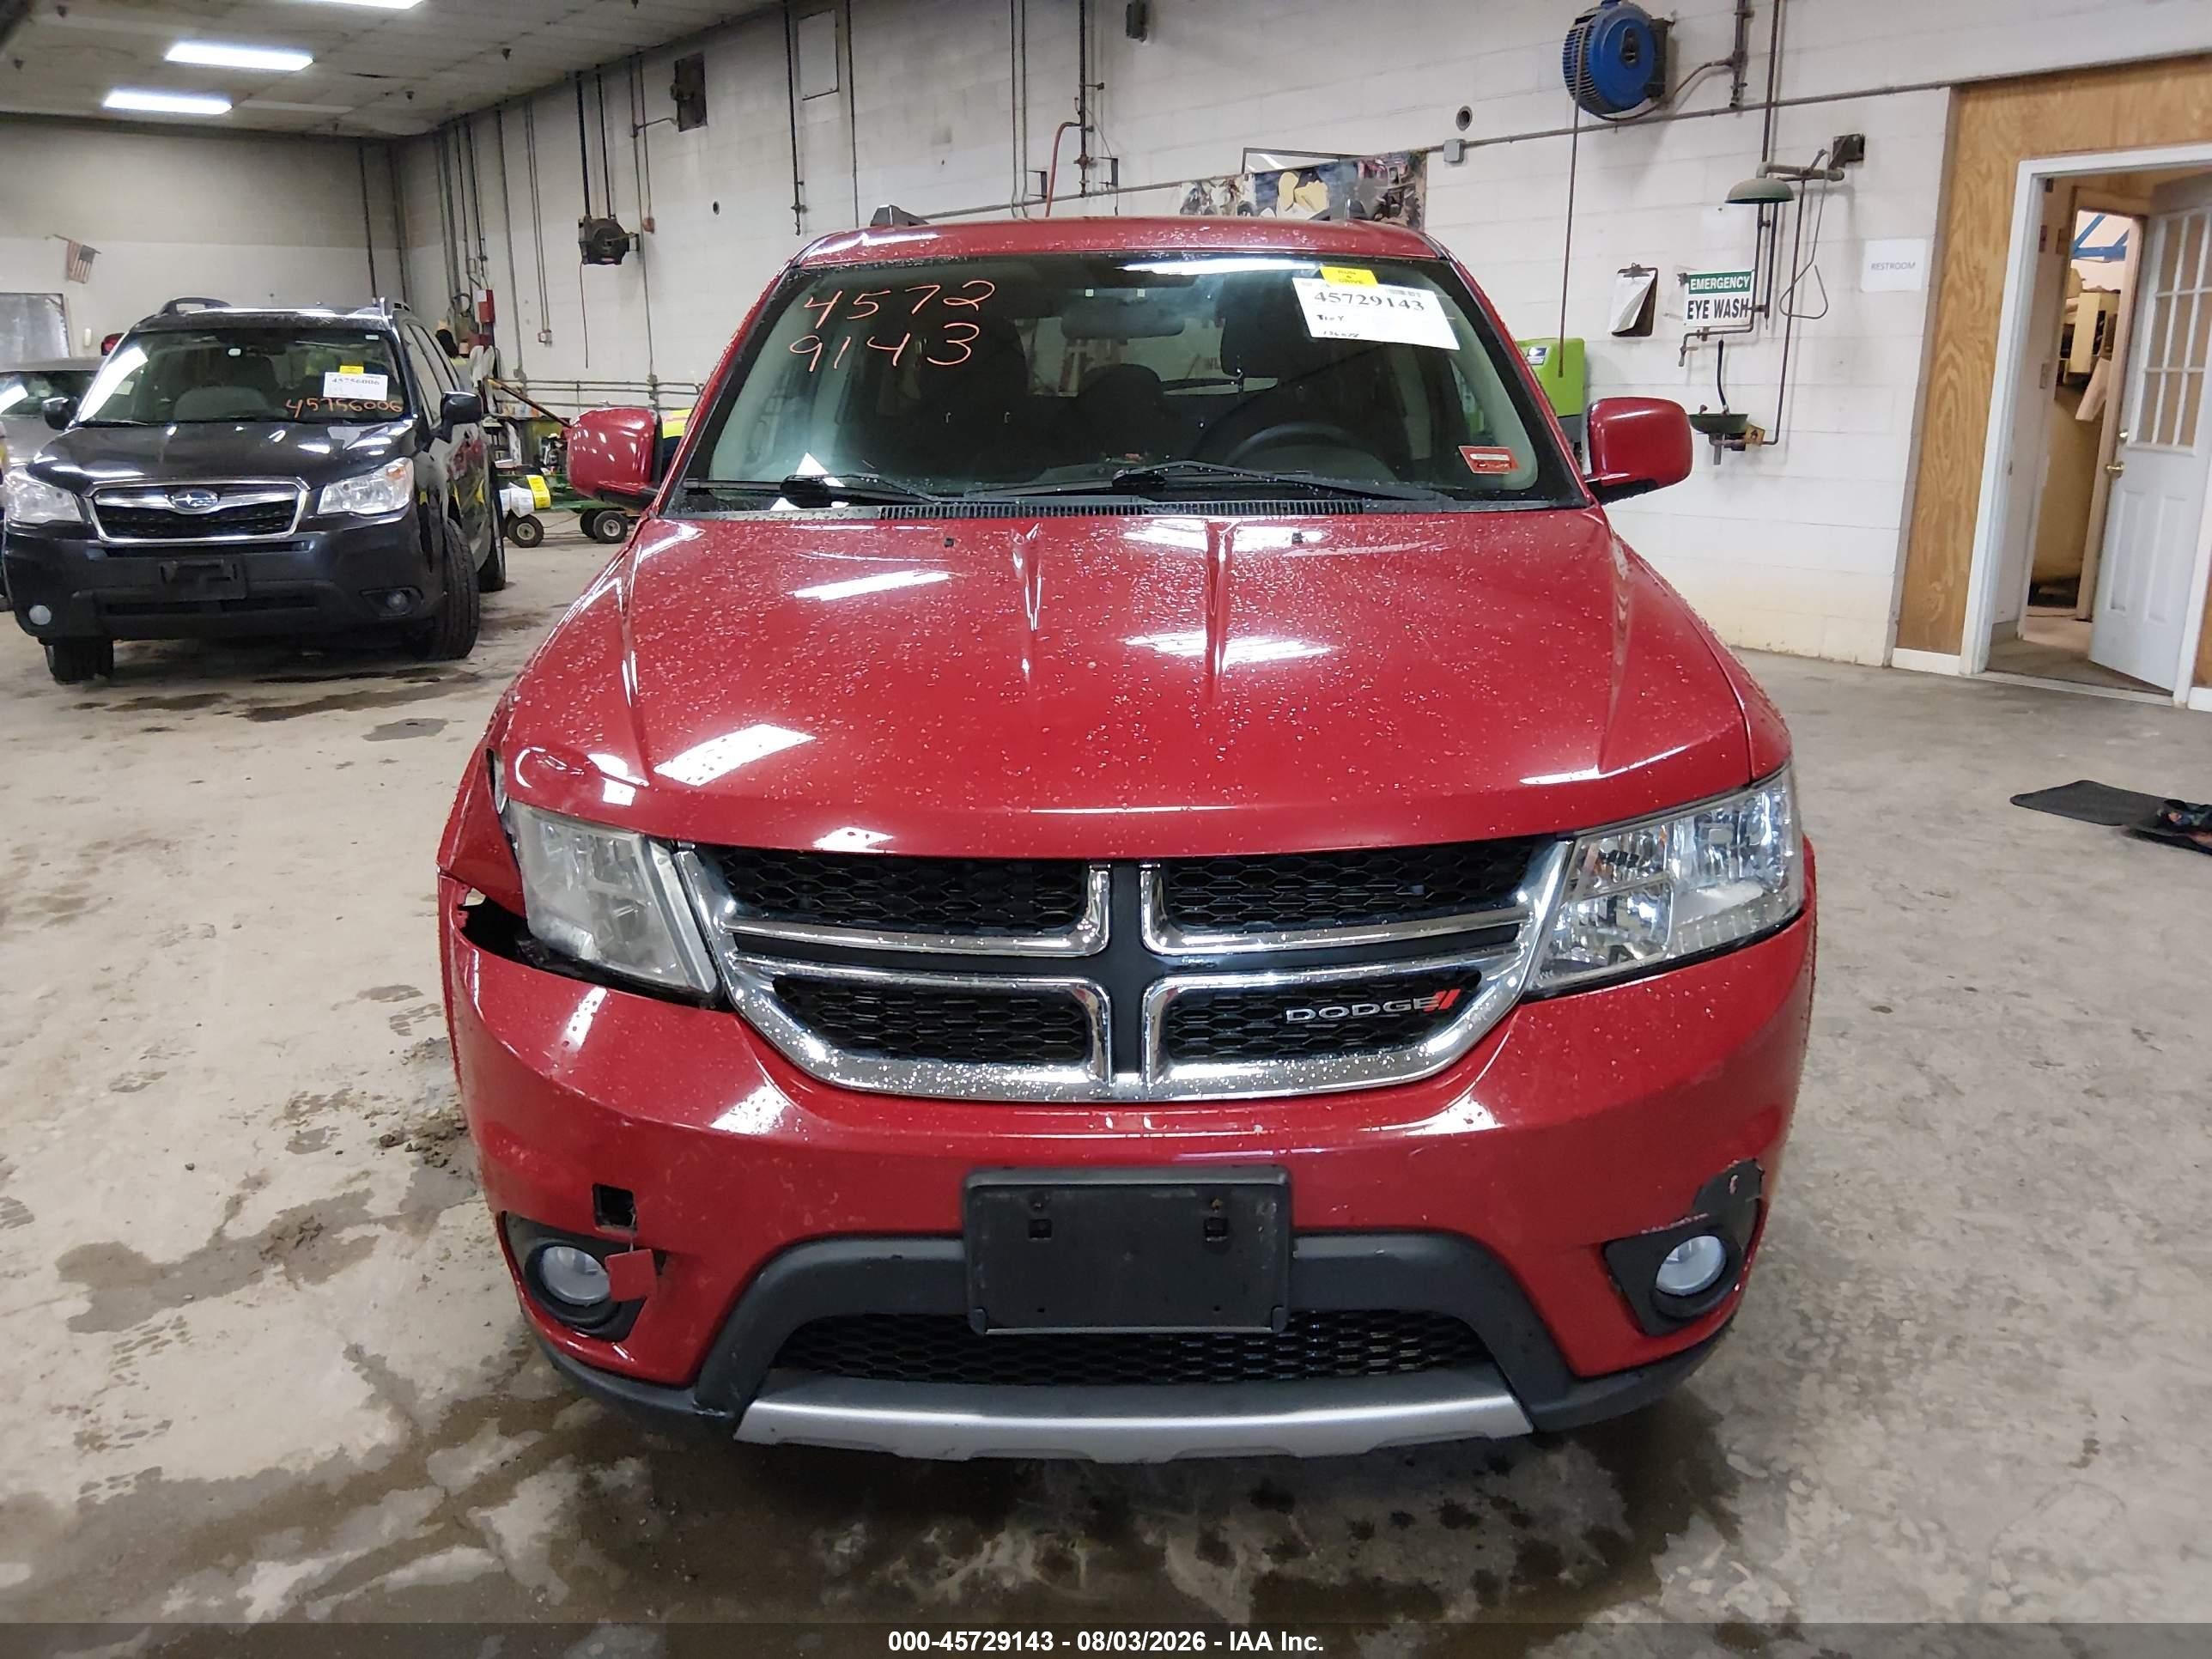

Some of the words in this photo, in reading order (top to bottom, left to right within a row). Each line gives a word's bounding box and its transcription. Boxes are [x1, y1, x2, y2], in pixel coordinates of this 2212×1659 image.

[1871, 261, 1916, 270] RESTROOM
[1690, 276, 1750, 290] EMERGENCY
[804, 280, 996, 330] 4572
[1314, 291, 1425, 312] 45729143
[1687, 300, 1710, 319] EYE
[1714, 297, 1749, 319] WASH
[790, 322, 980, 373] 9143
[285, 398, 404, 419] 45756006
[1286, 996, 1440, 1024] DODGE
